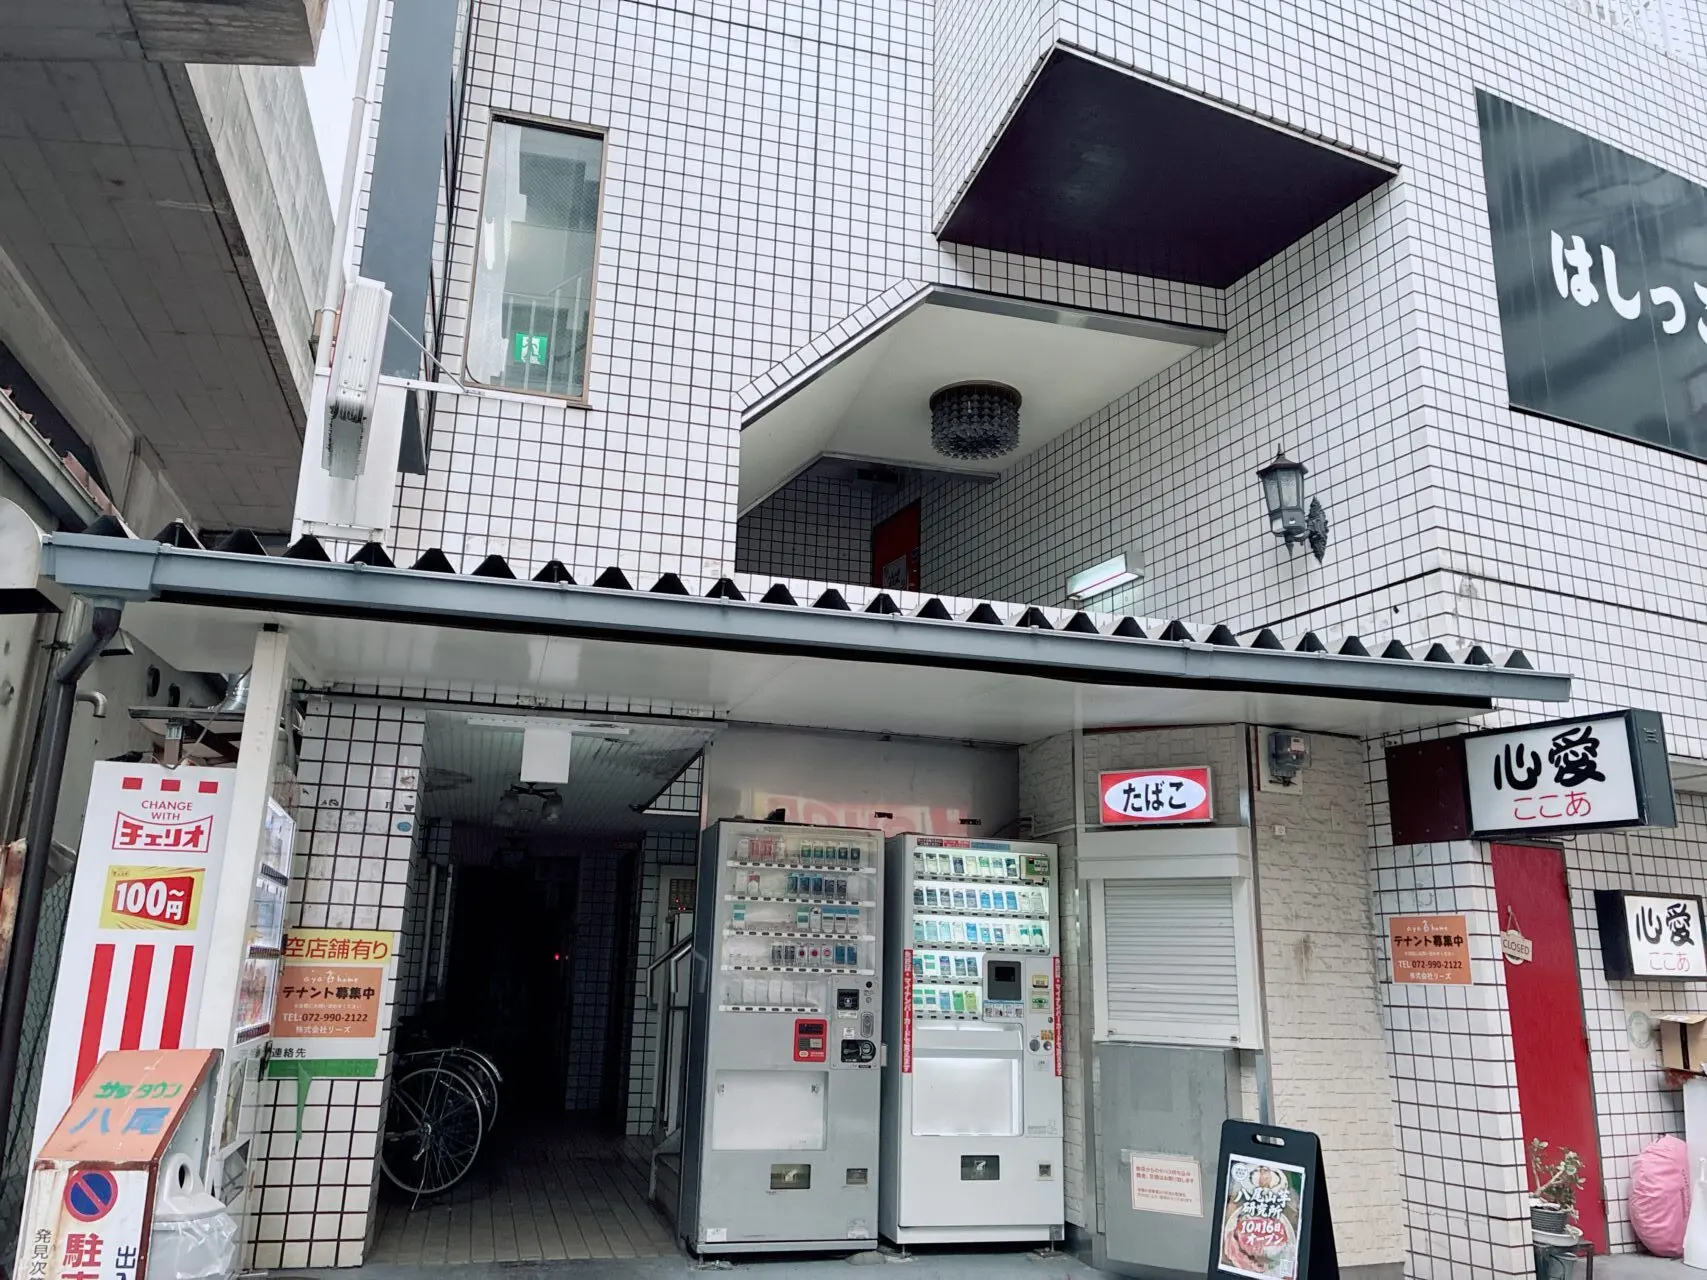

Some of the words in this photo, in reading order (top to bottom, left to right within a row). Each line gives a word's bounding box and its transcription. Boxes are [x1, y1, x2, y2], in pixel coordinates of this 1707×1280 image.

[1494, 725, 1606, 790] 心愛
[141, 800, 193, 811] CHANGE
[1123, 781, 1187, 812] たばこ
[1514, 791, 1591, 820] ここあ
[151, 812, 181, 821] WITH
[119, 820, 204, 848] チェリオ
[1636, 903, 1695, 947] 心愛
[284, 938, 388, 961] 空店舗有り
[1394, 935, 1464, 948] テナント募集中
[1503, 939, 1530, 955] CLOSED
[1648, 952, 1690, 972] ここあ
[283, 987, 375, 1000] テナント募集中
[296, 1026, 351, 1034] 株式会社リーズ
[272, 1047, 307, 1058] 連絡先
[1234, 1187, 1291, 1207] 八尾山芋
[1242, 1202, 1282, 1219] 研究所
[1246, 1233, 1285, 1246] オープン
[61, 1233, 104, 1280] 駐
